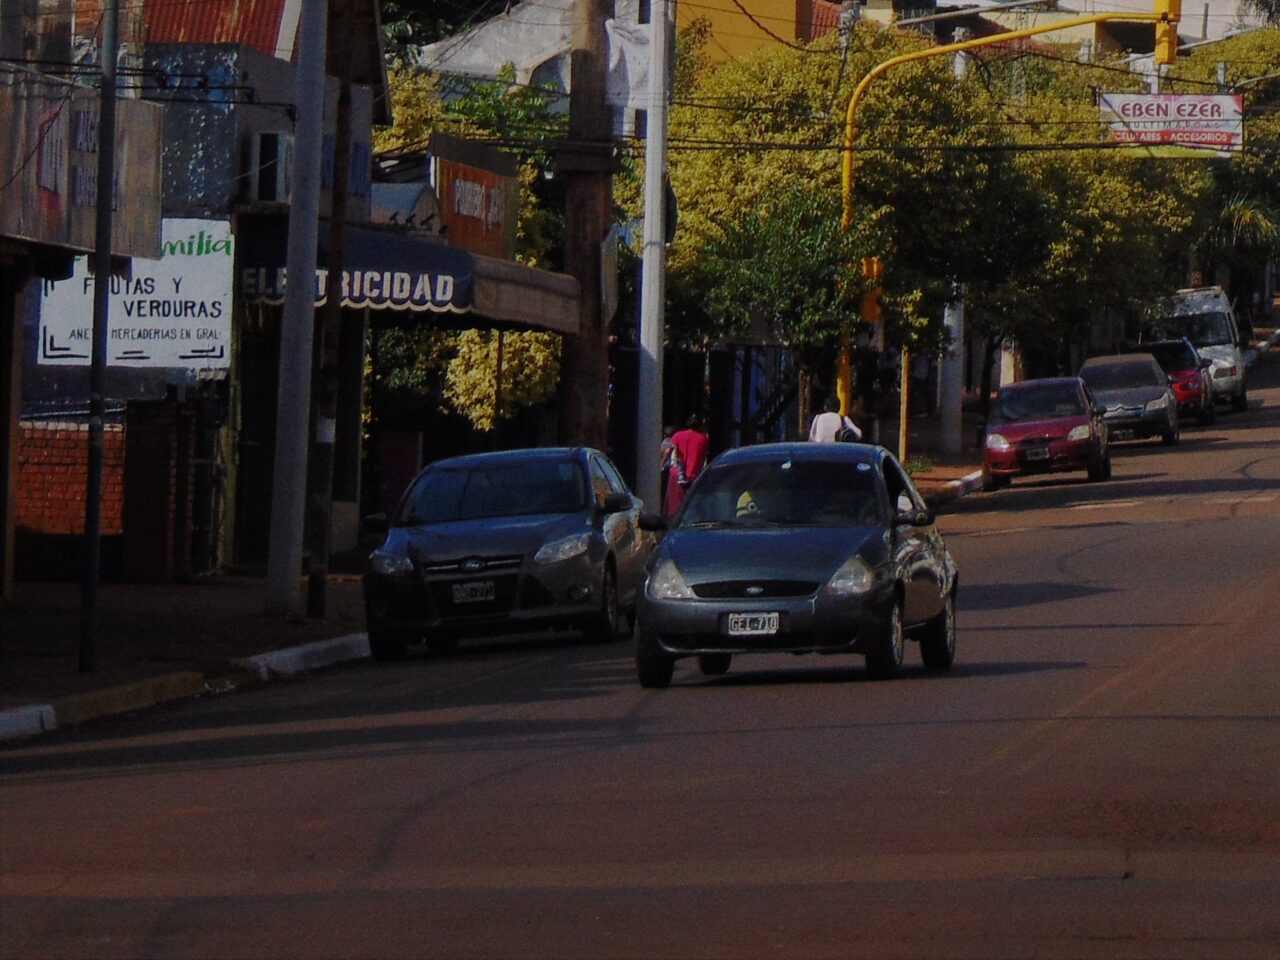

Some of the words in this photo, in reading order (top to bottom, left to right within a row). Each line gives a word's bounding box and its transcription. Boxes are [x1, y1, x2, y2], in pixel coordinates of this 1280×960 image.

[1120, 102, 1169, 118] EBEN
[1176, 103, 1222, 119] EZER
[1169, 132, 1228, 142] ACCESORIOS
[161, 230, 232, 258] milia
[84, 277, 155, 295] FUTAS
[172, 277, 183, 293] Y
[242, 267, 454, 302] ELETRICIDAD
[123, 299, 222, 319] VERDURAS
[111, 328, 177, 340] MERCADERIAS
[180, 328, 191, 340] EN
